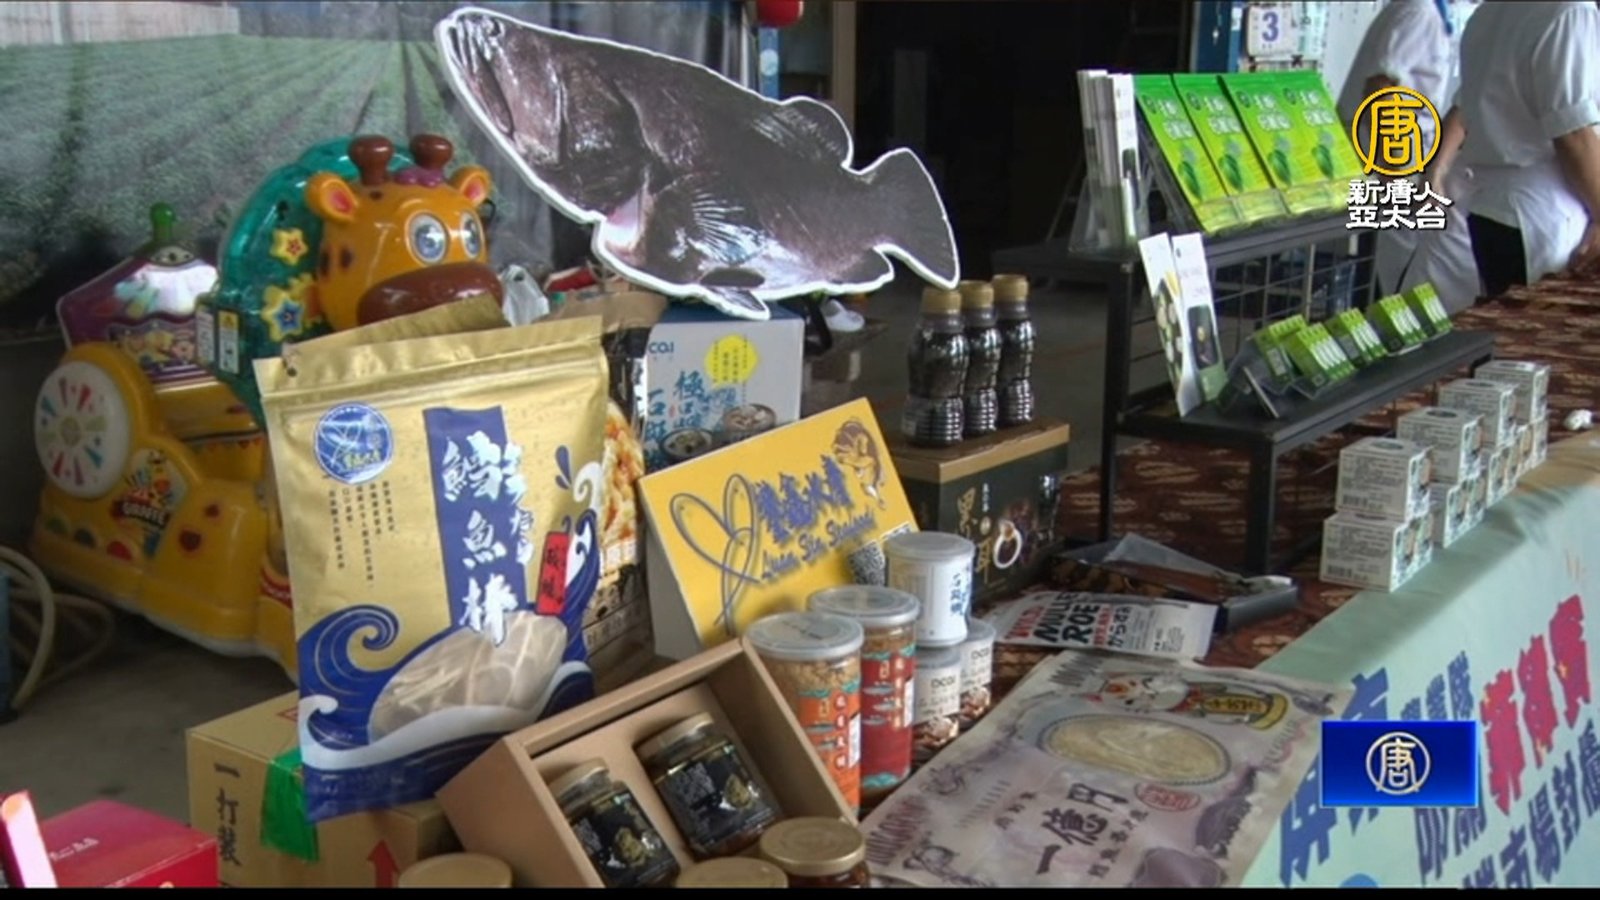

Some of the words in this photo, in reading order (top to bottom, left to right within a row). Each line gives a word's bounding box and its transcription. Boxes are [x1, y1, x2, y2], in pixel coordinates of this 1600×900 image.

[1261, 11, 1280, 42] 3
[1062, 604, 1100, 644] ROE
[214, 762, 242, 867] 一打裝
[1036, 782, 1128, 874] 一億円
